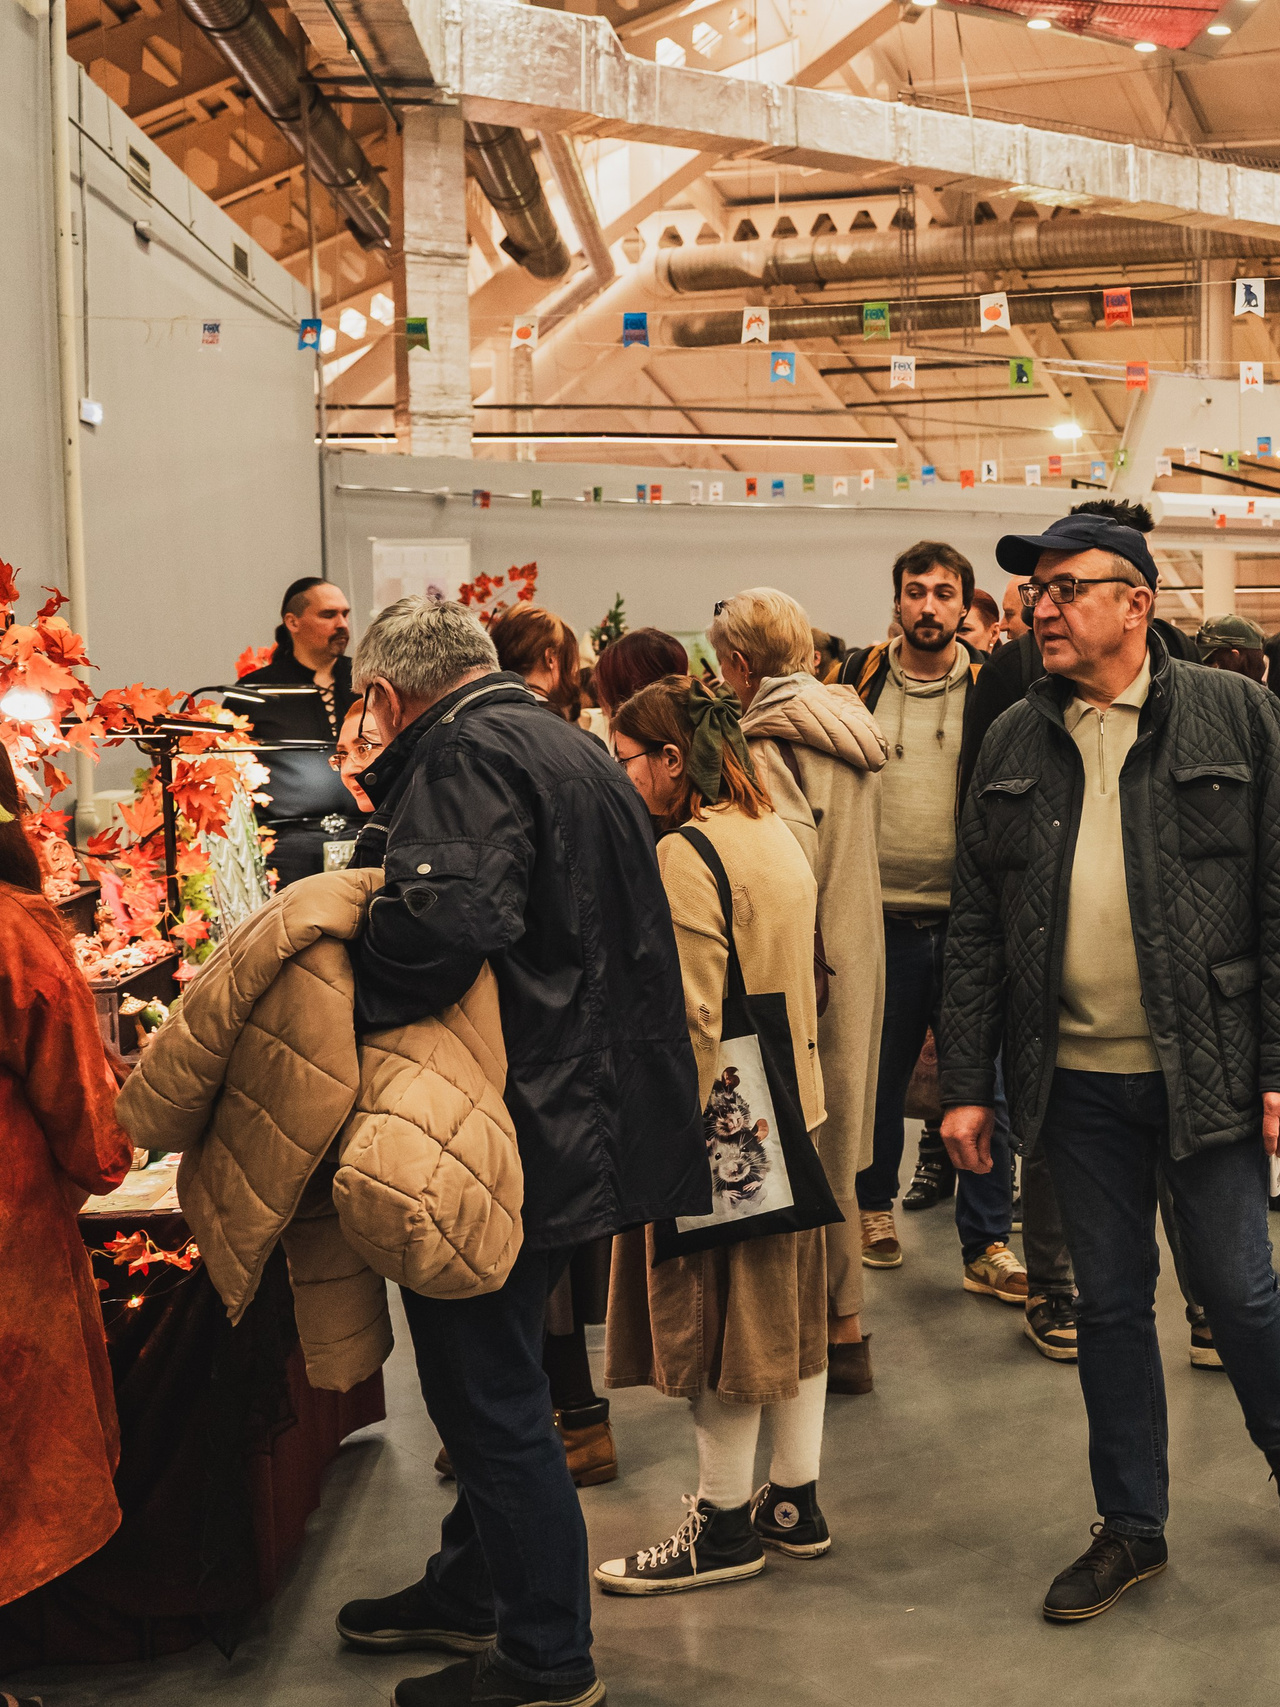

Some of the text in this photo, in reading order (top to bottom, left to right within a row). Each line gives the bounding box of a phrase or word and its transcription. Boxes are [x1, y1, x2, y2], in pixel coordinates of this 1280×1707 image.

[1106, 294, 1128, 306] FOX
[865, 308, 886, 320] FOX
[203, 323, 221, 334] FOX
[893, 361, 913, 372] FOX
